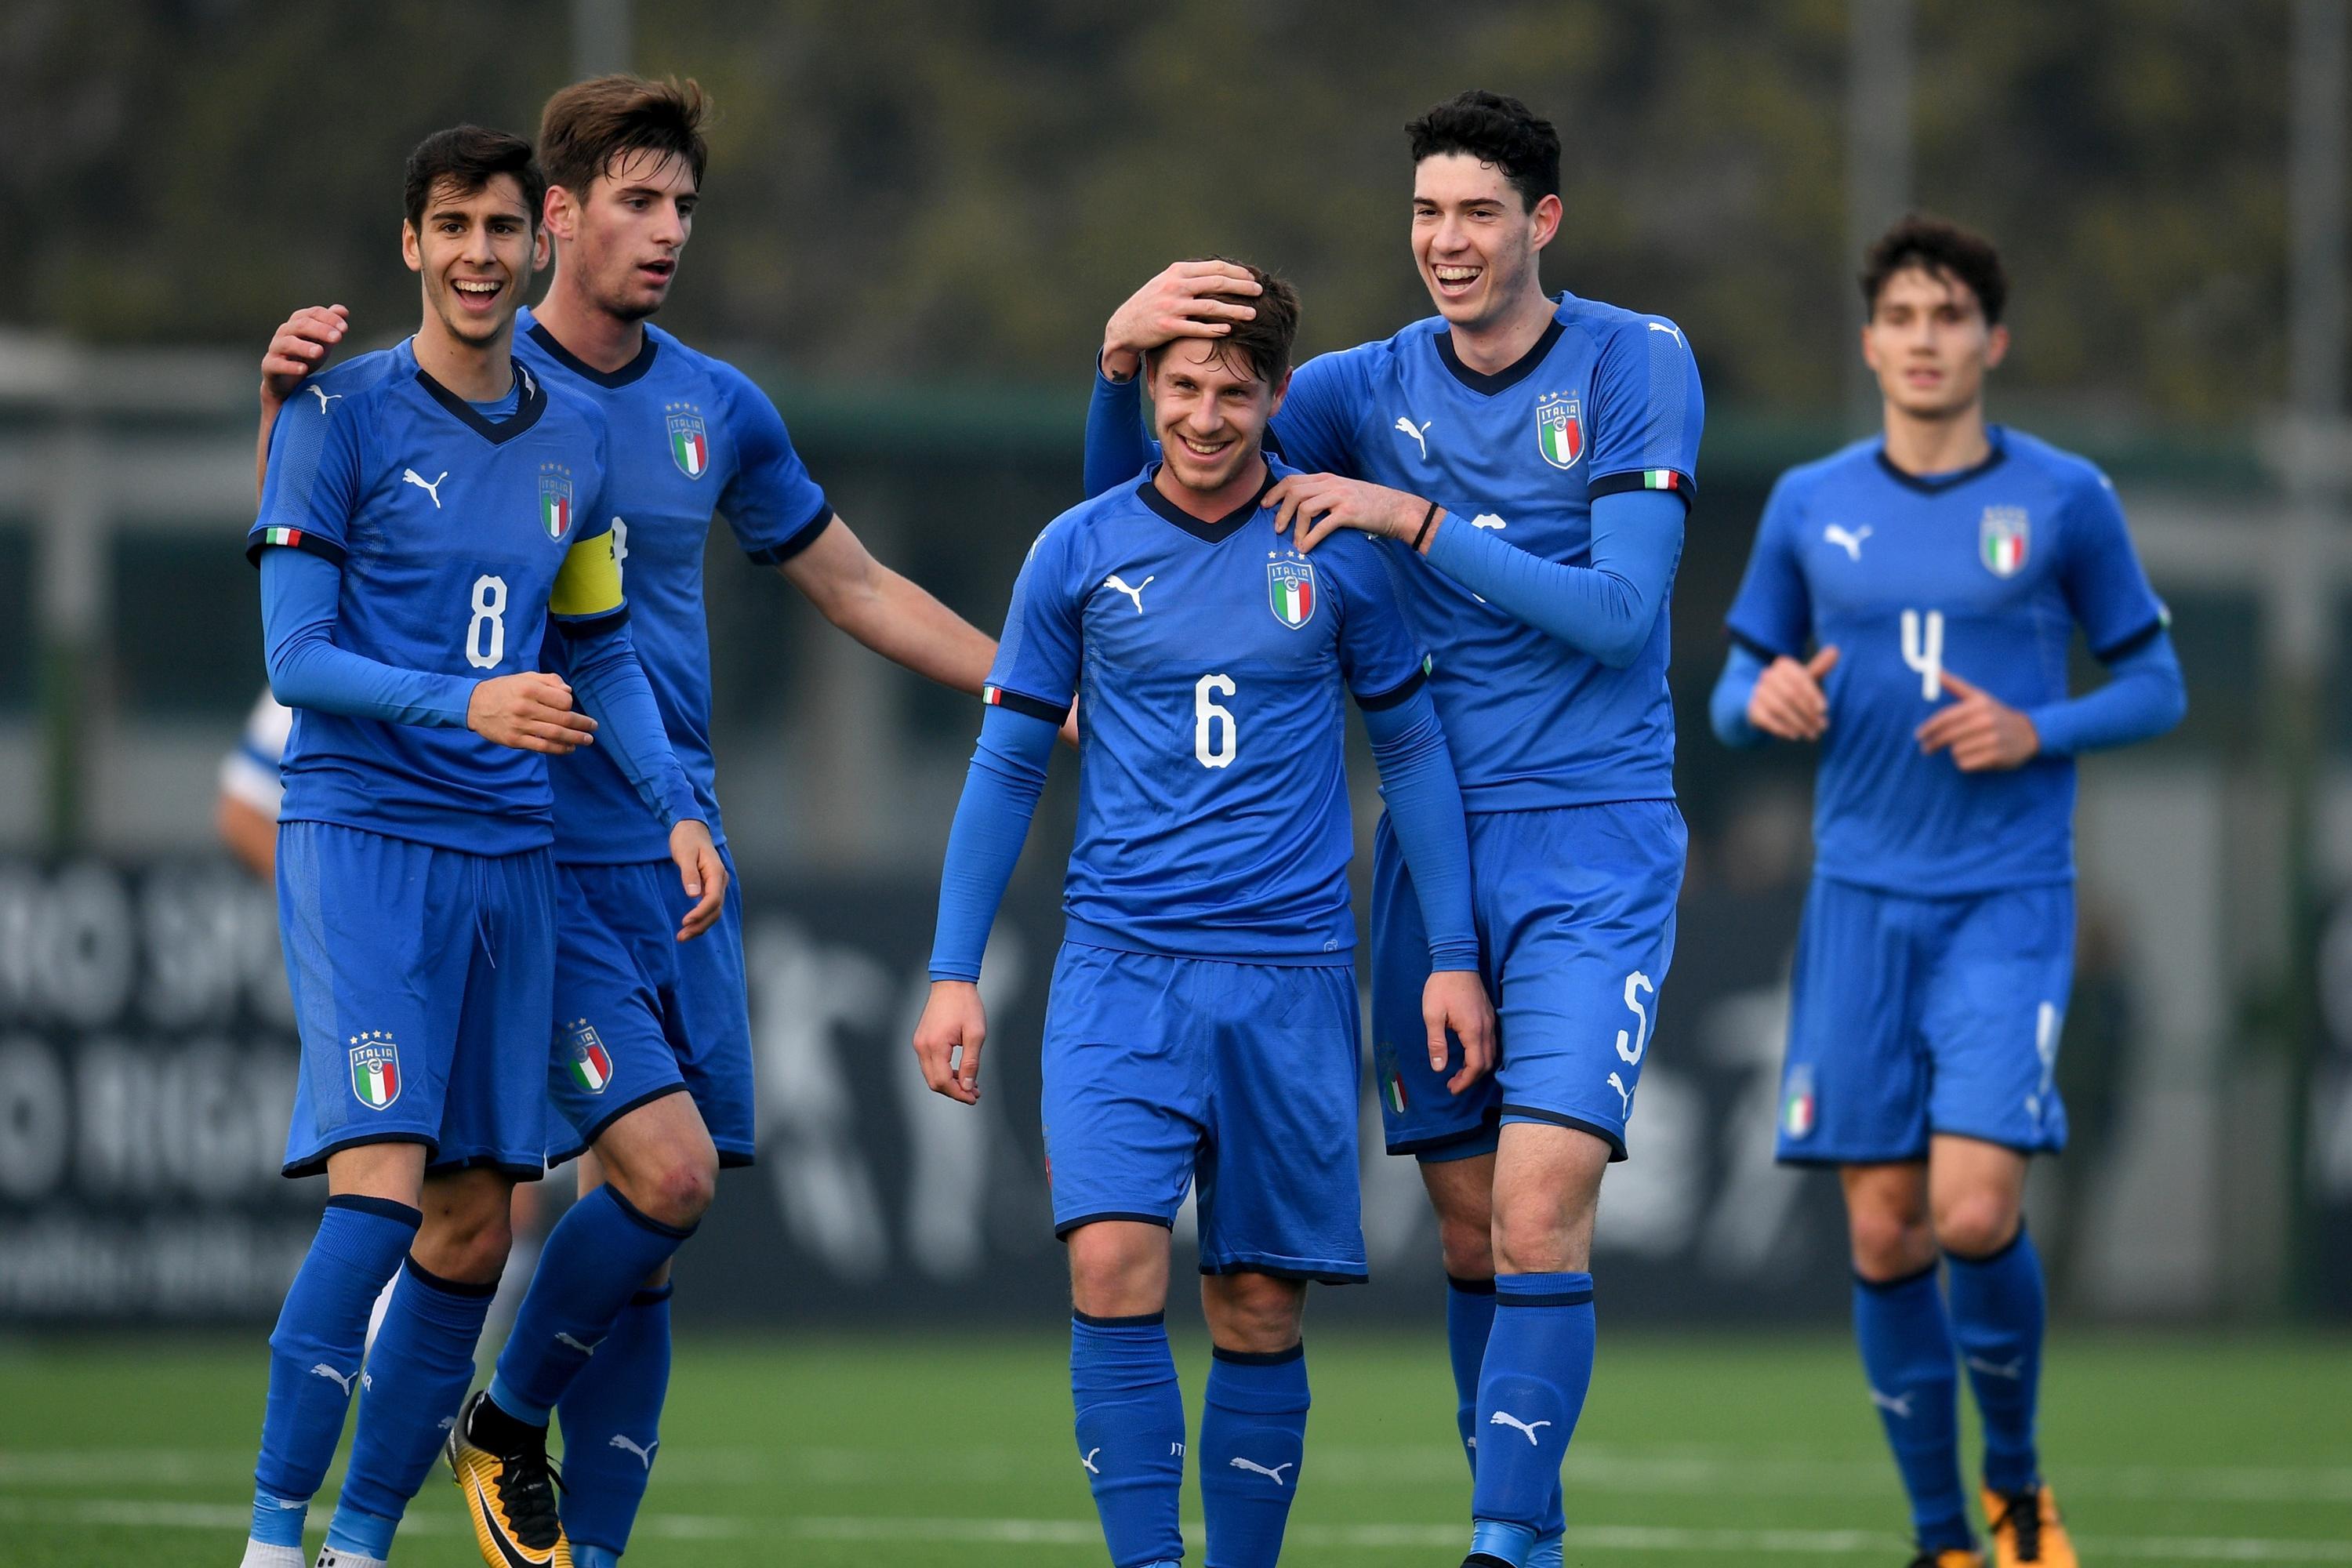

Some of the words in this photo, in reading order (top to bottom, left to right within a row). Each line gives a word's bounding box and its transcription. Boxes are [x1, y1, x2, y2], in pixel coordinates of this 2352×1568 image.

[1541, 405, 1576, 420] ITALIA
[670, 419, 701, 430] ITALIA
[541, 479, 569, 492] ITALIA
[1272, 566, 1308, 578] ITALIA
[466, 574, 507, 670] 8
[1900, 609, 1944, 701] 4
[1196, 673, 1236, 768] 6
[354, 1047, 394, 1062] ITALIA
